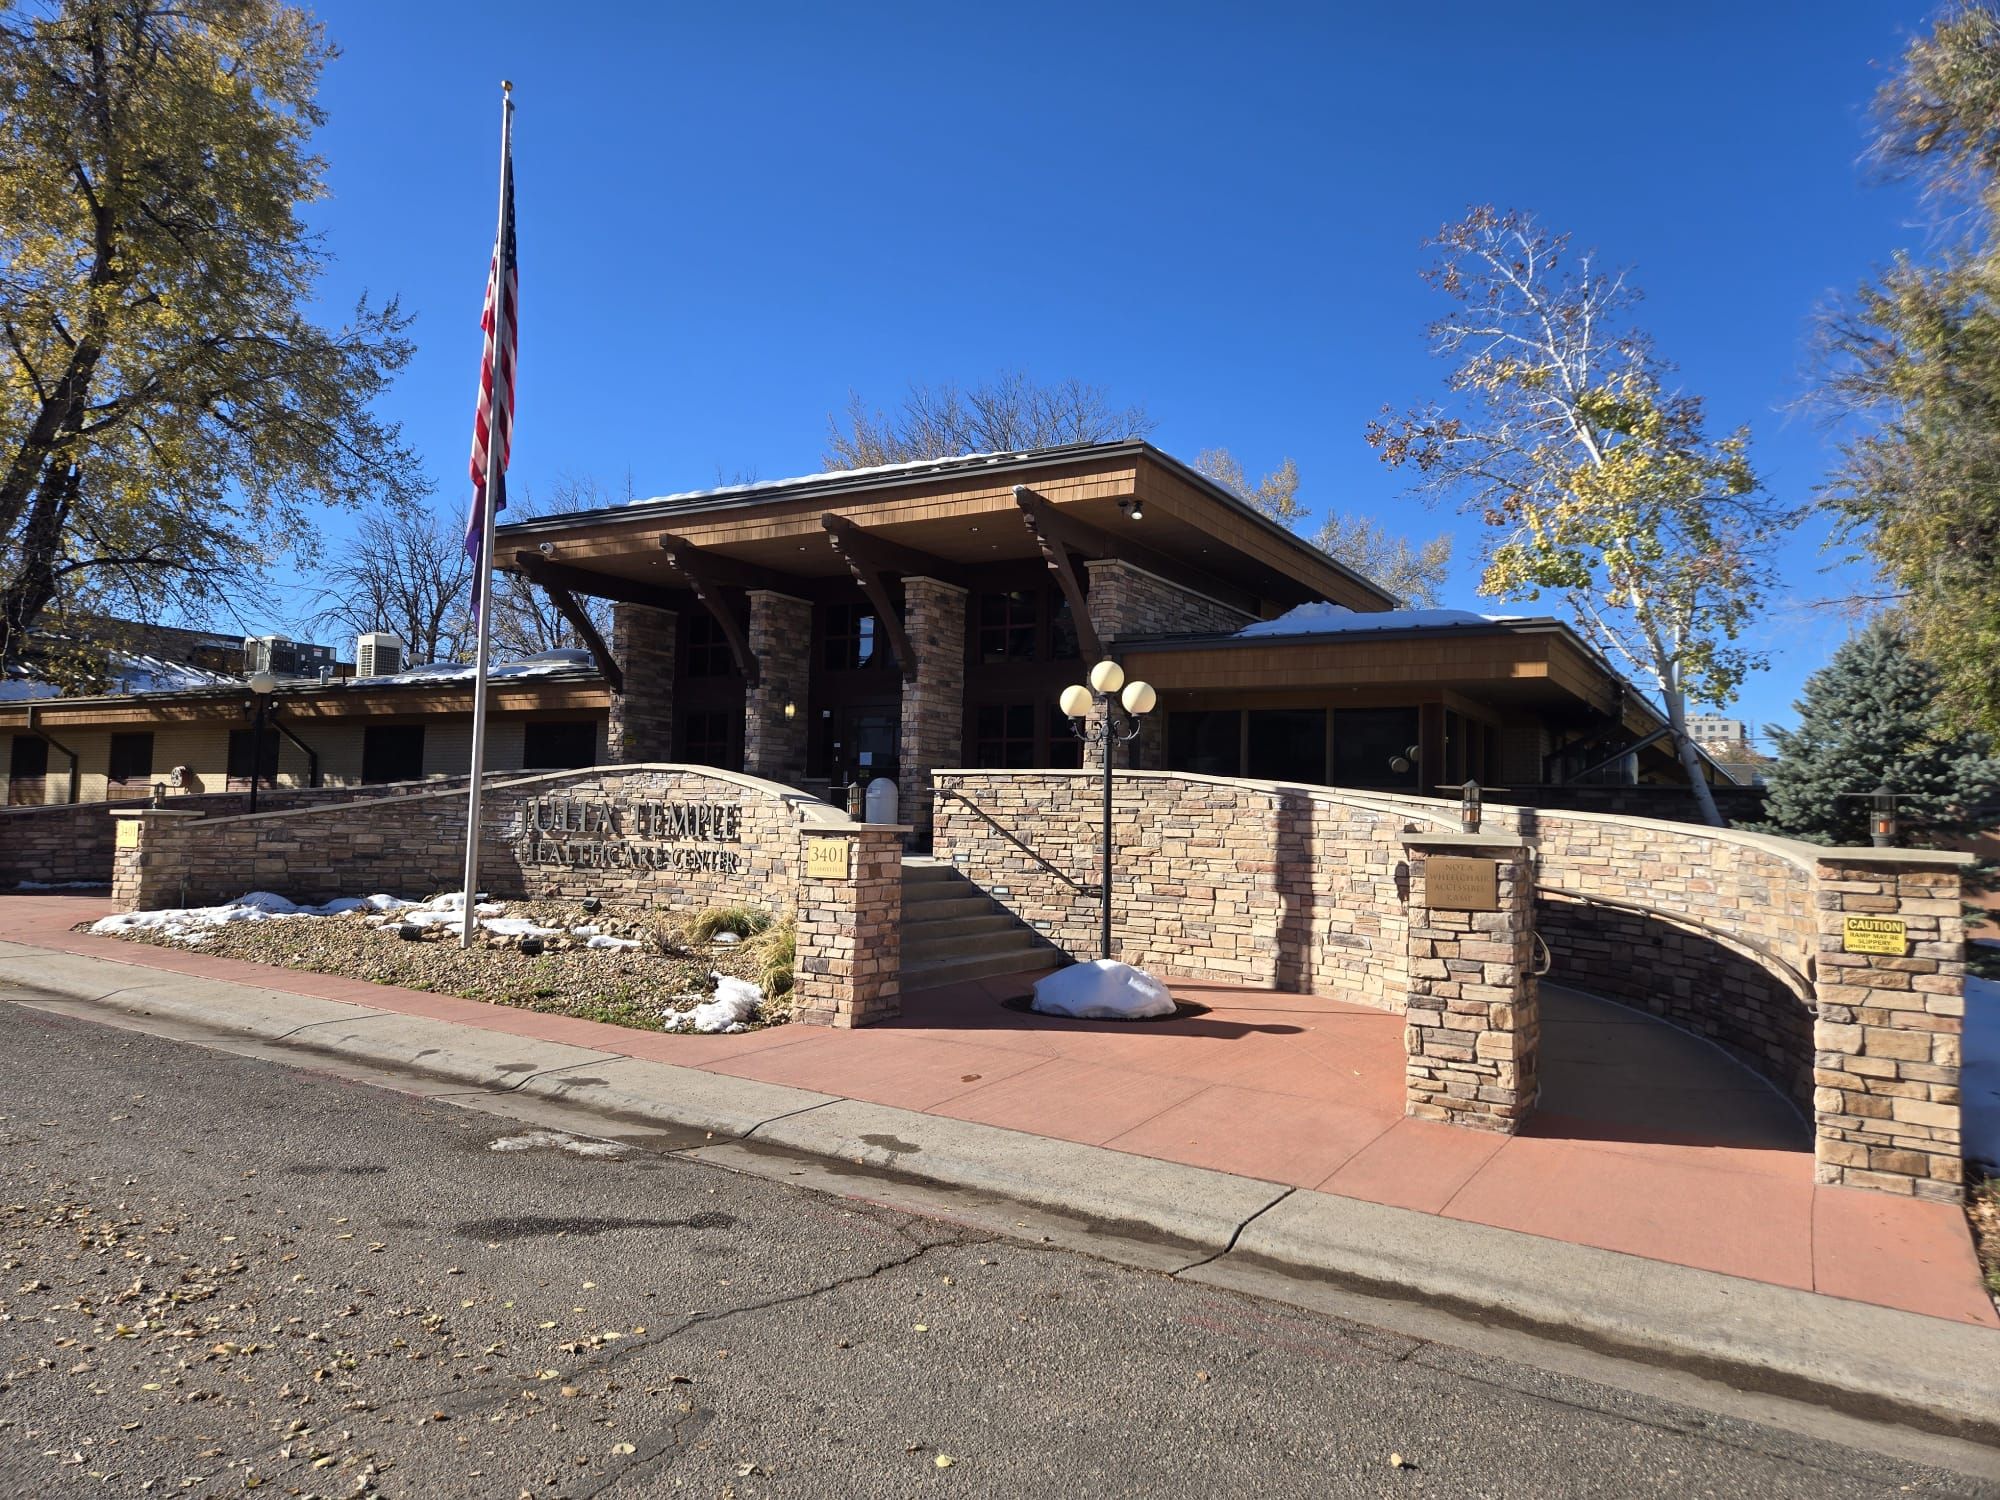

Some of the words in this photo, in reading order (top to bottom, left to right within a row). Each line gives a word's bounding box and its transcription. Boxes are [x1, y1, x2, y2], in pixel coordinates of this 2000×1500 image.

[514, 799, 618, 842] JULIA
[628, 801, 737, 840] TEMPLE
[519, 840, 665, 870] HEALTHCARE
[672, 848, 738, 874] CENTER
[811, 846, 844, 862] 3401
[1445, 863, 1465, 871] NOT
[1429, 872, 1490, 882] WHEELCHAIR
[1434, 883, 1486, 892] ACCESSIBLE
[1447, 894, 1474, 902] RAMP
[1848, 919, 1901, 932] CAUTION
[1858, 938, 1891, 946] SLIPPERY
